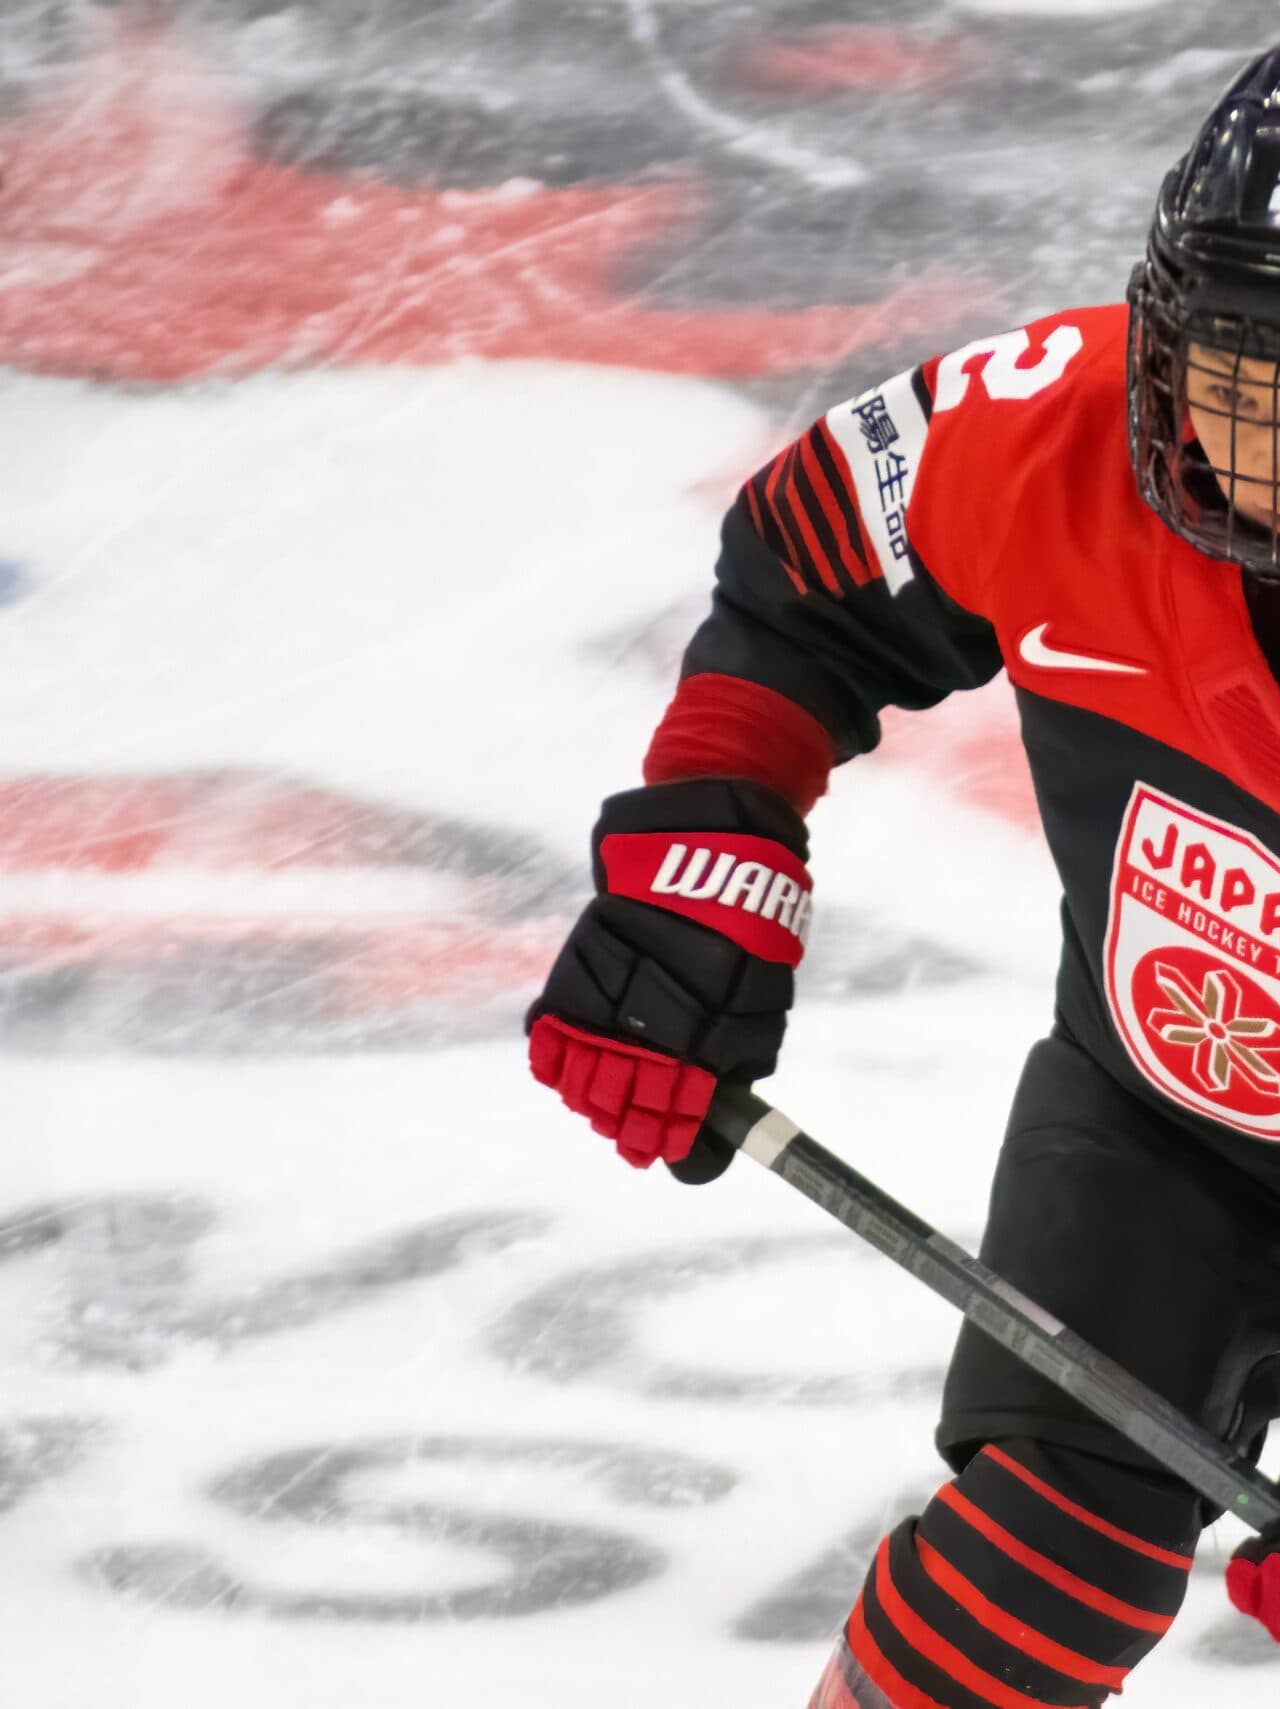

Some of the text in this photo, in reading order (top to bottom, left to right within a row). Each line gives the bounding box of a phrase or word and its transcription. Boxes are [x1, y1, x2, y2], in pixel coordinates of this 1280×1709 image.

[932, 325, 1083, 412] 2
[1131, 875, 1167, 909] ICE
[1178, 905, 1263, 963] HOCKEY
